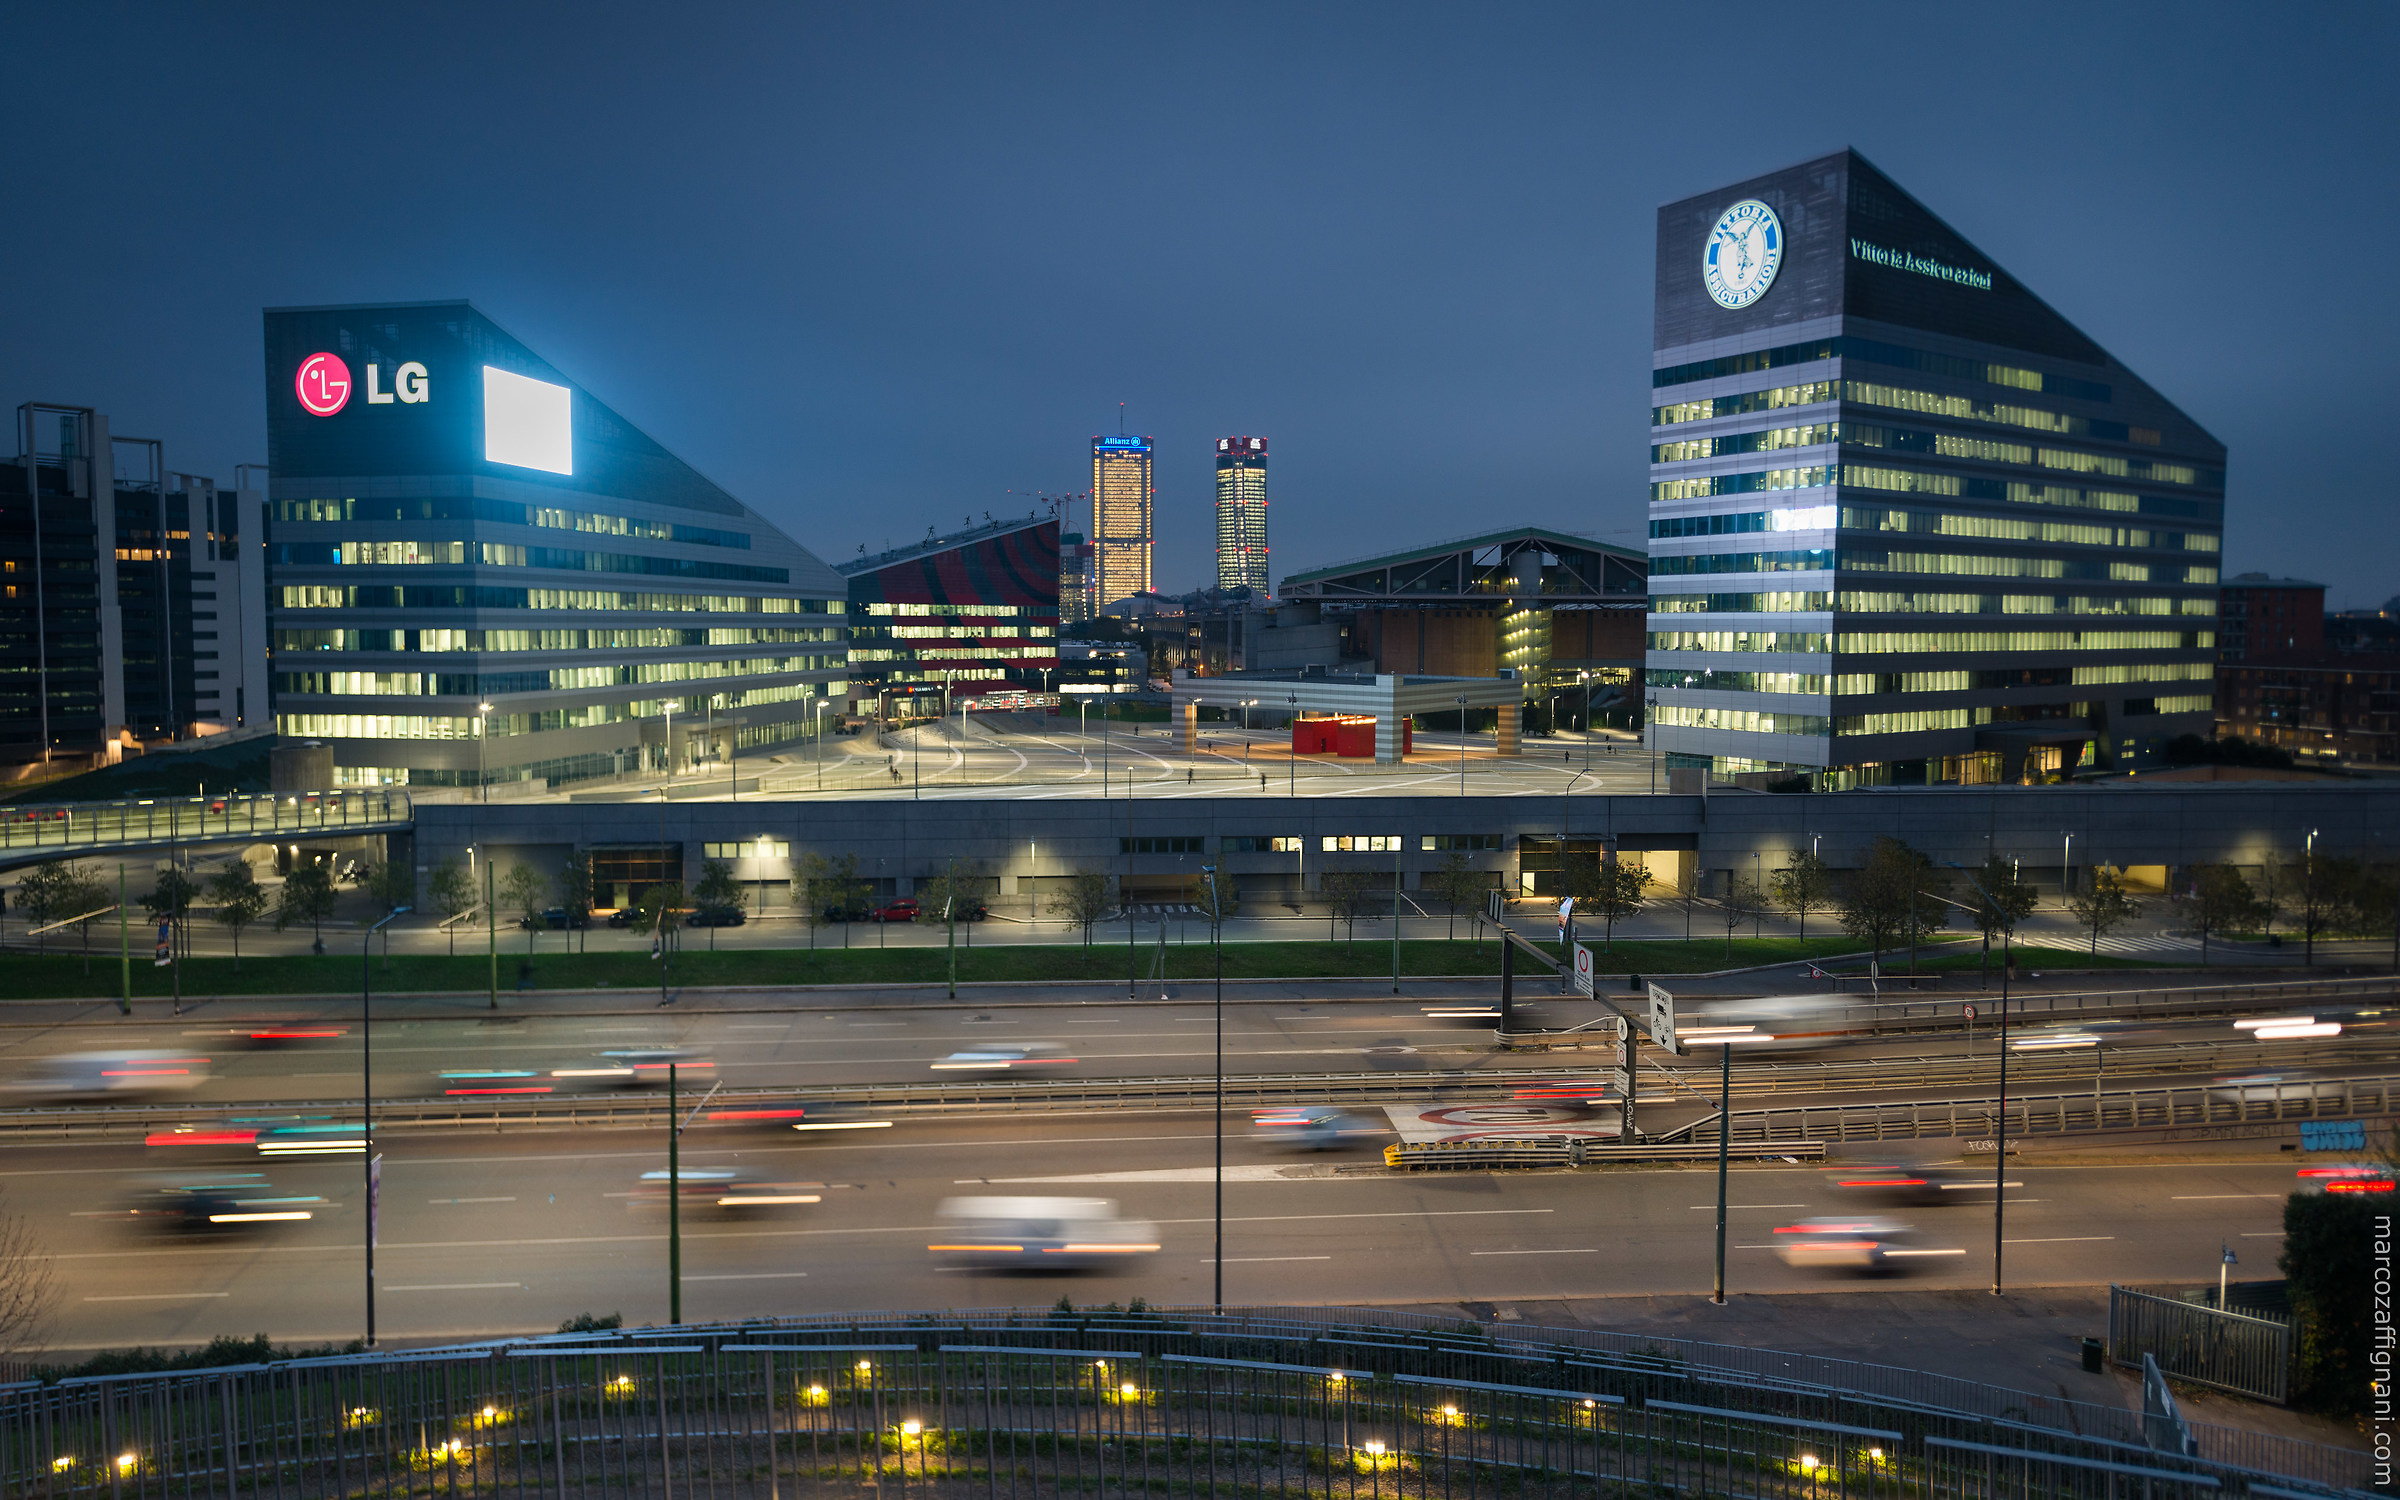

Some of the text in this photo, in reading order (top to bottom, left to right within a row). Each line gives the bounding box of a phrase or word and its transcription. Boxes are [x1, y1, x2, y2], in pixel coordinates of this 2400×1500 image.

[1712, 205, 1773, 244] VITTORIA
[1708, 248, 1777, 304] ASSICURAZIONI
[367, 361, 429, 404] LG
[1104, 437, 1130, 445] Allianz
